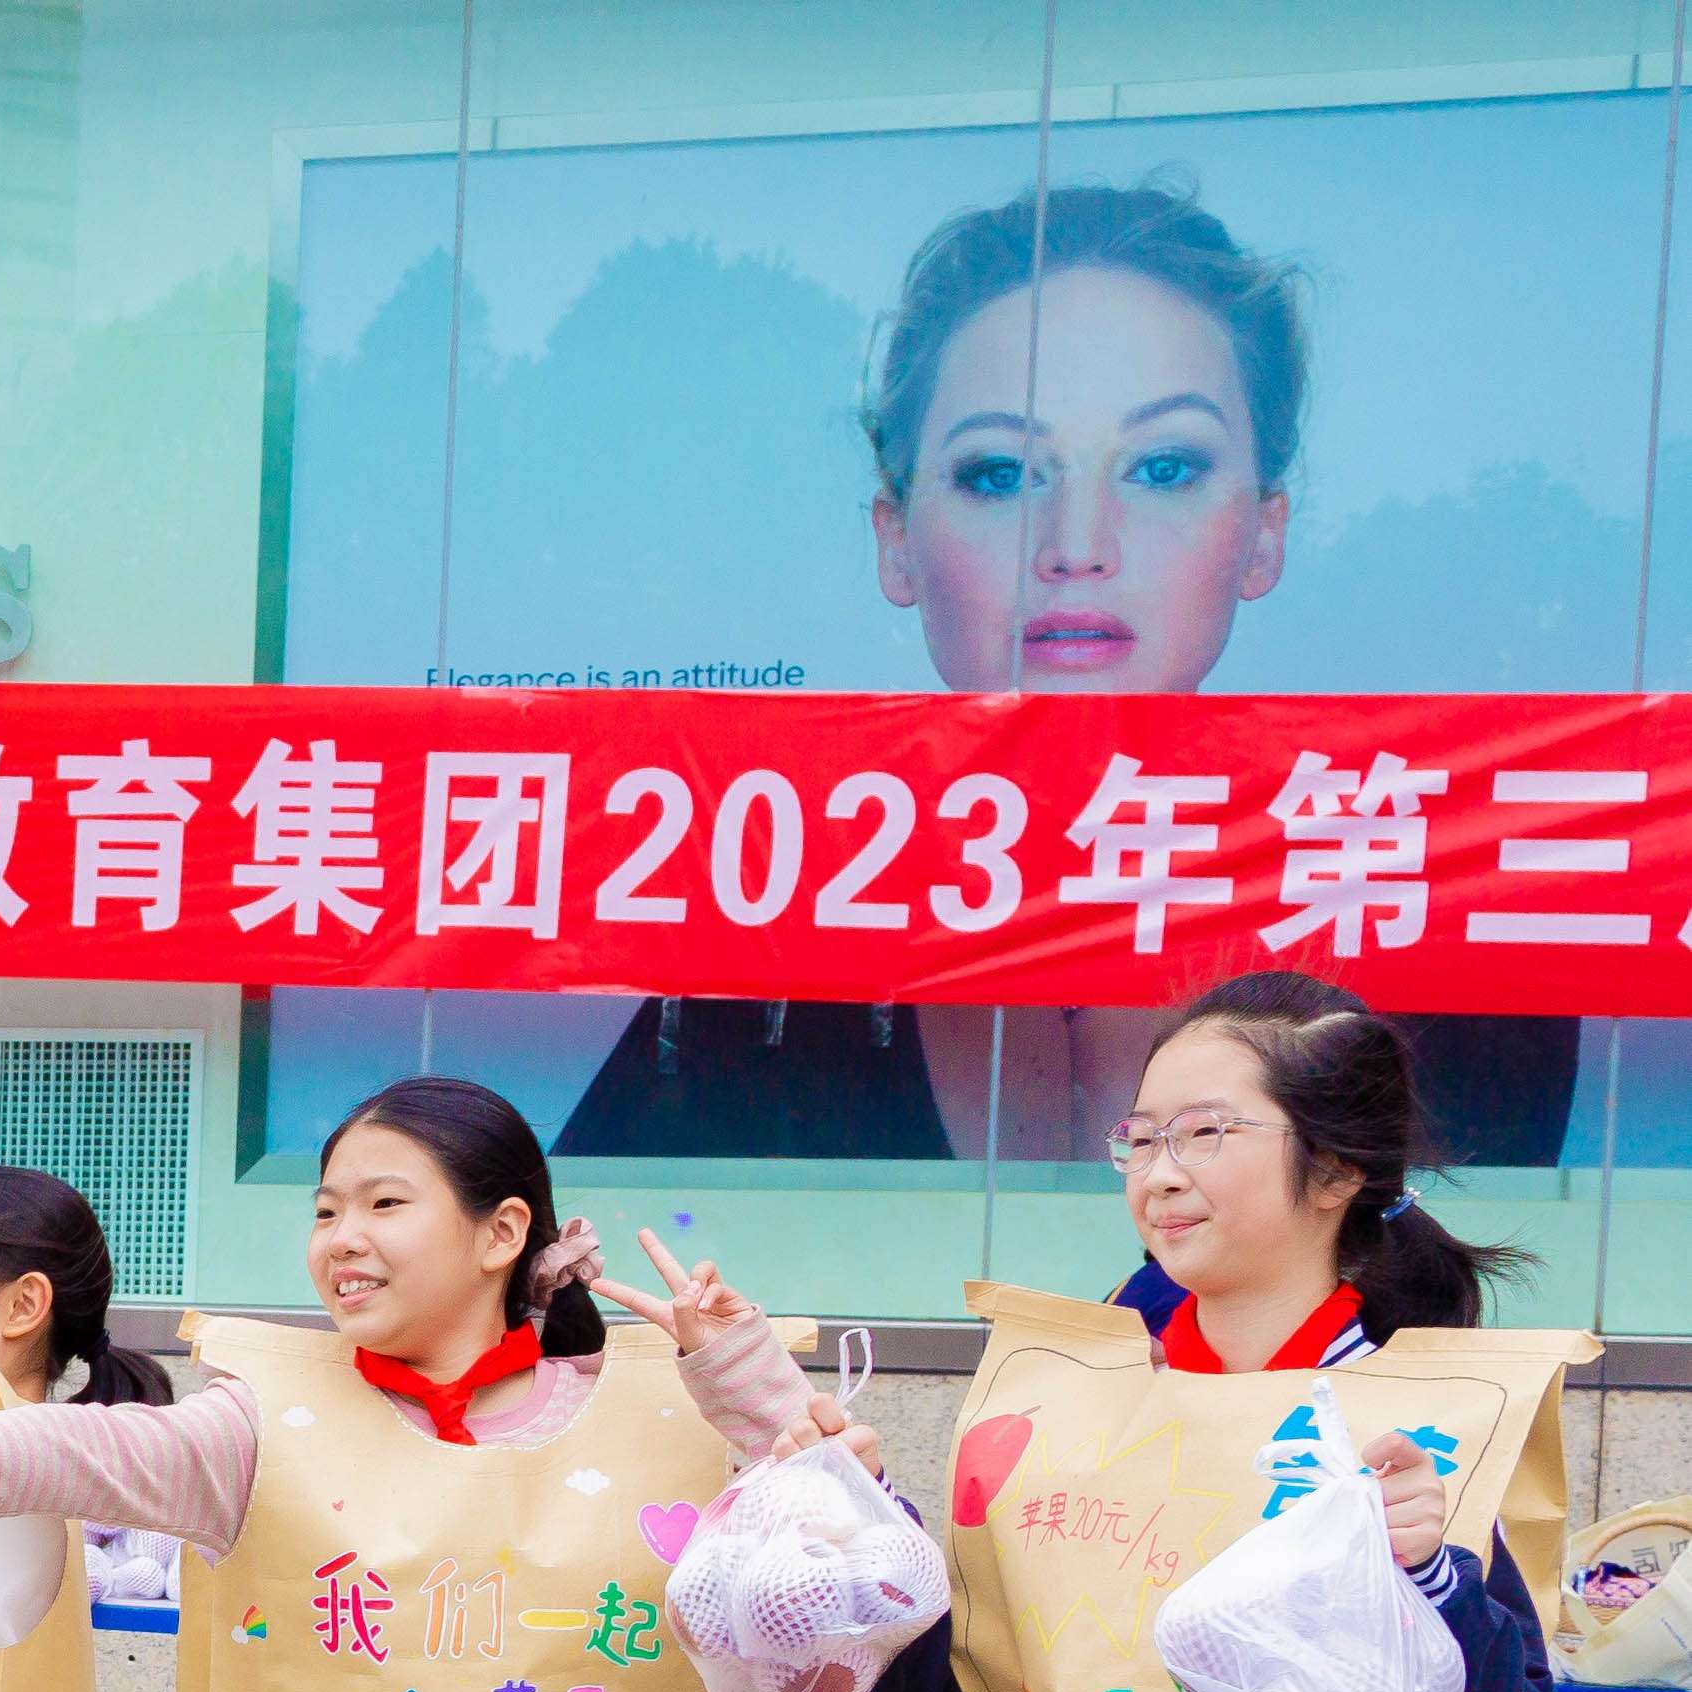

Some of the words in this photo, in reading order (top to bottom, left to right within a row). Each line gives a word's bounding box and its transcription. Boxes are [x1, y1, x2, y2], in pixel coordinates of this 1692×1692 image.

[587, 665, 611, 688] is
[622, 669, 661, 688] an
[672, 659, 805, 688] attitude
[311, 1549, 663, 1668] 我们一起
